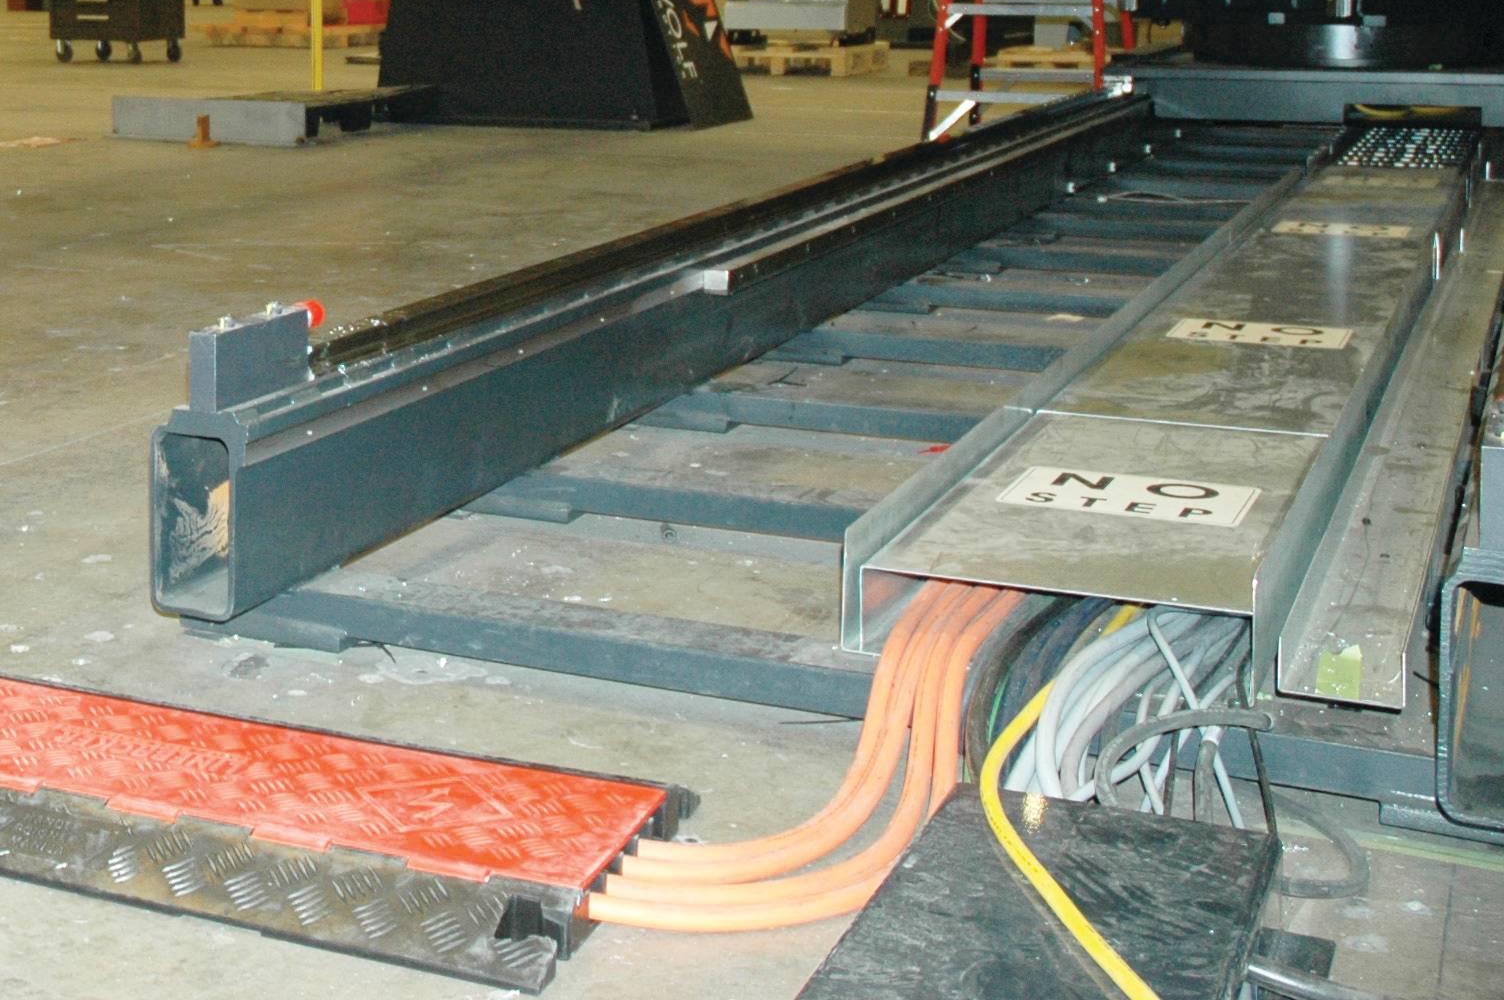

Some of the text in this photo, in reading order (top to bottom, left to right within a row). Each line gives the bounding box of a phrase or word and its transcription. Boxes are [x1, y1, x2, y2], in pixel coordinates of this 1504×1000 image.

[1202, 321, 1324, 336] NO
[1051, 472, 1219, 500] NO
[1025, 491, 1213, 518] STEP
